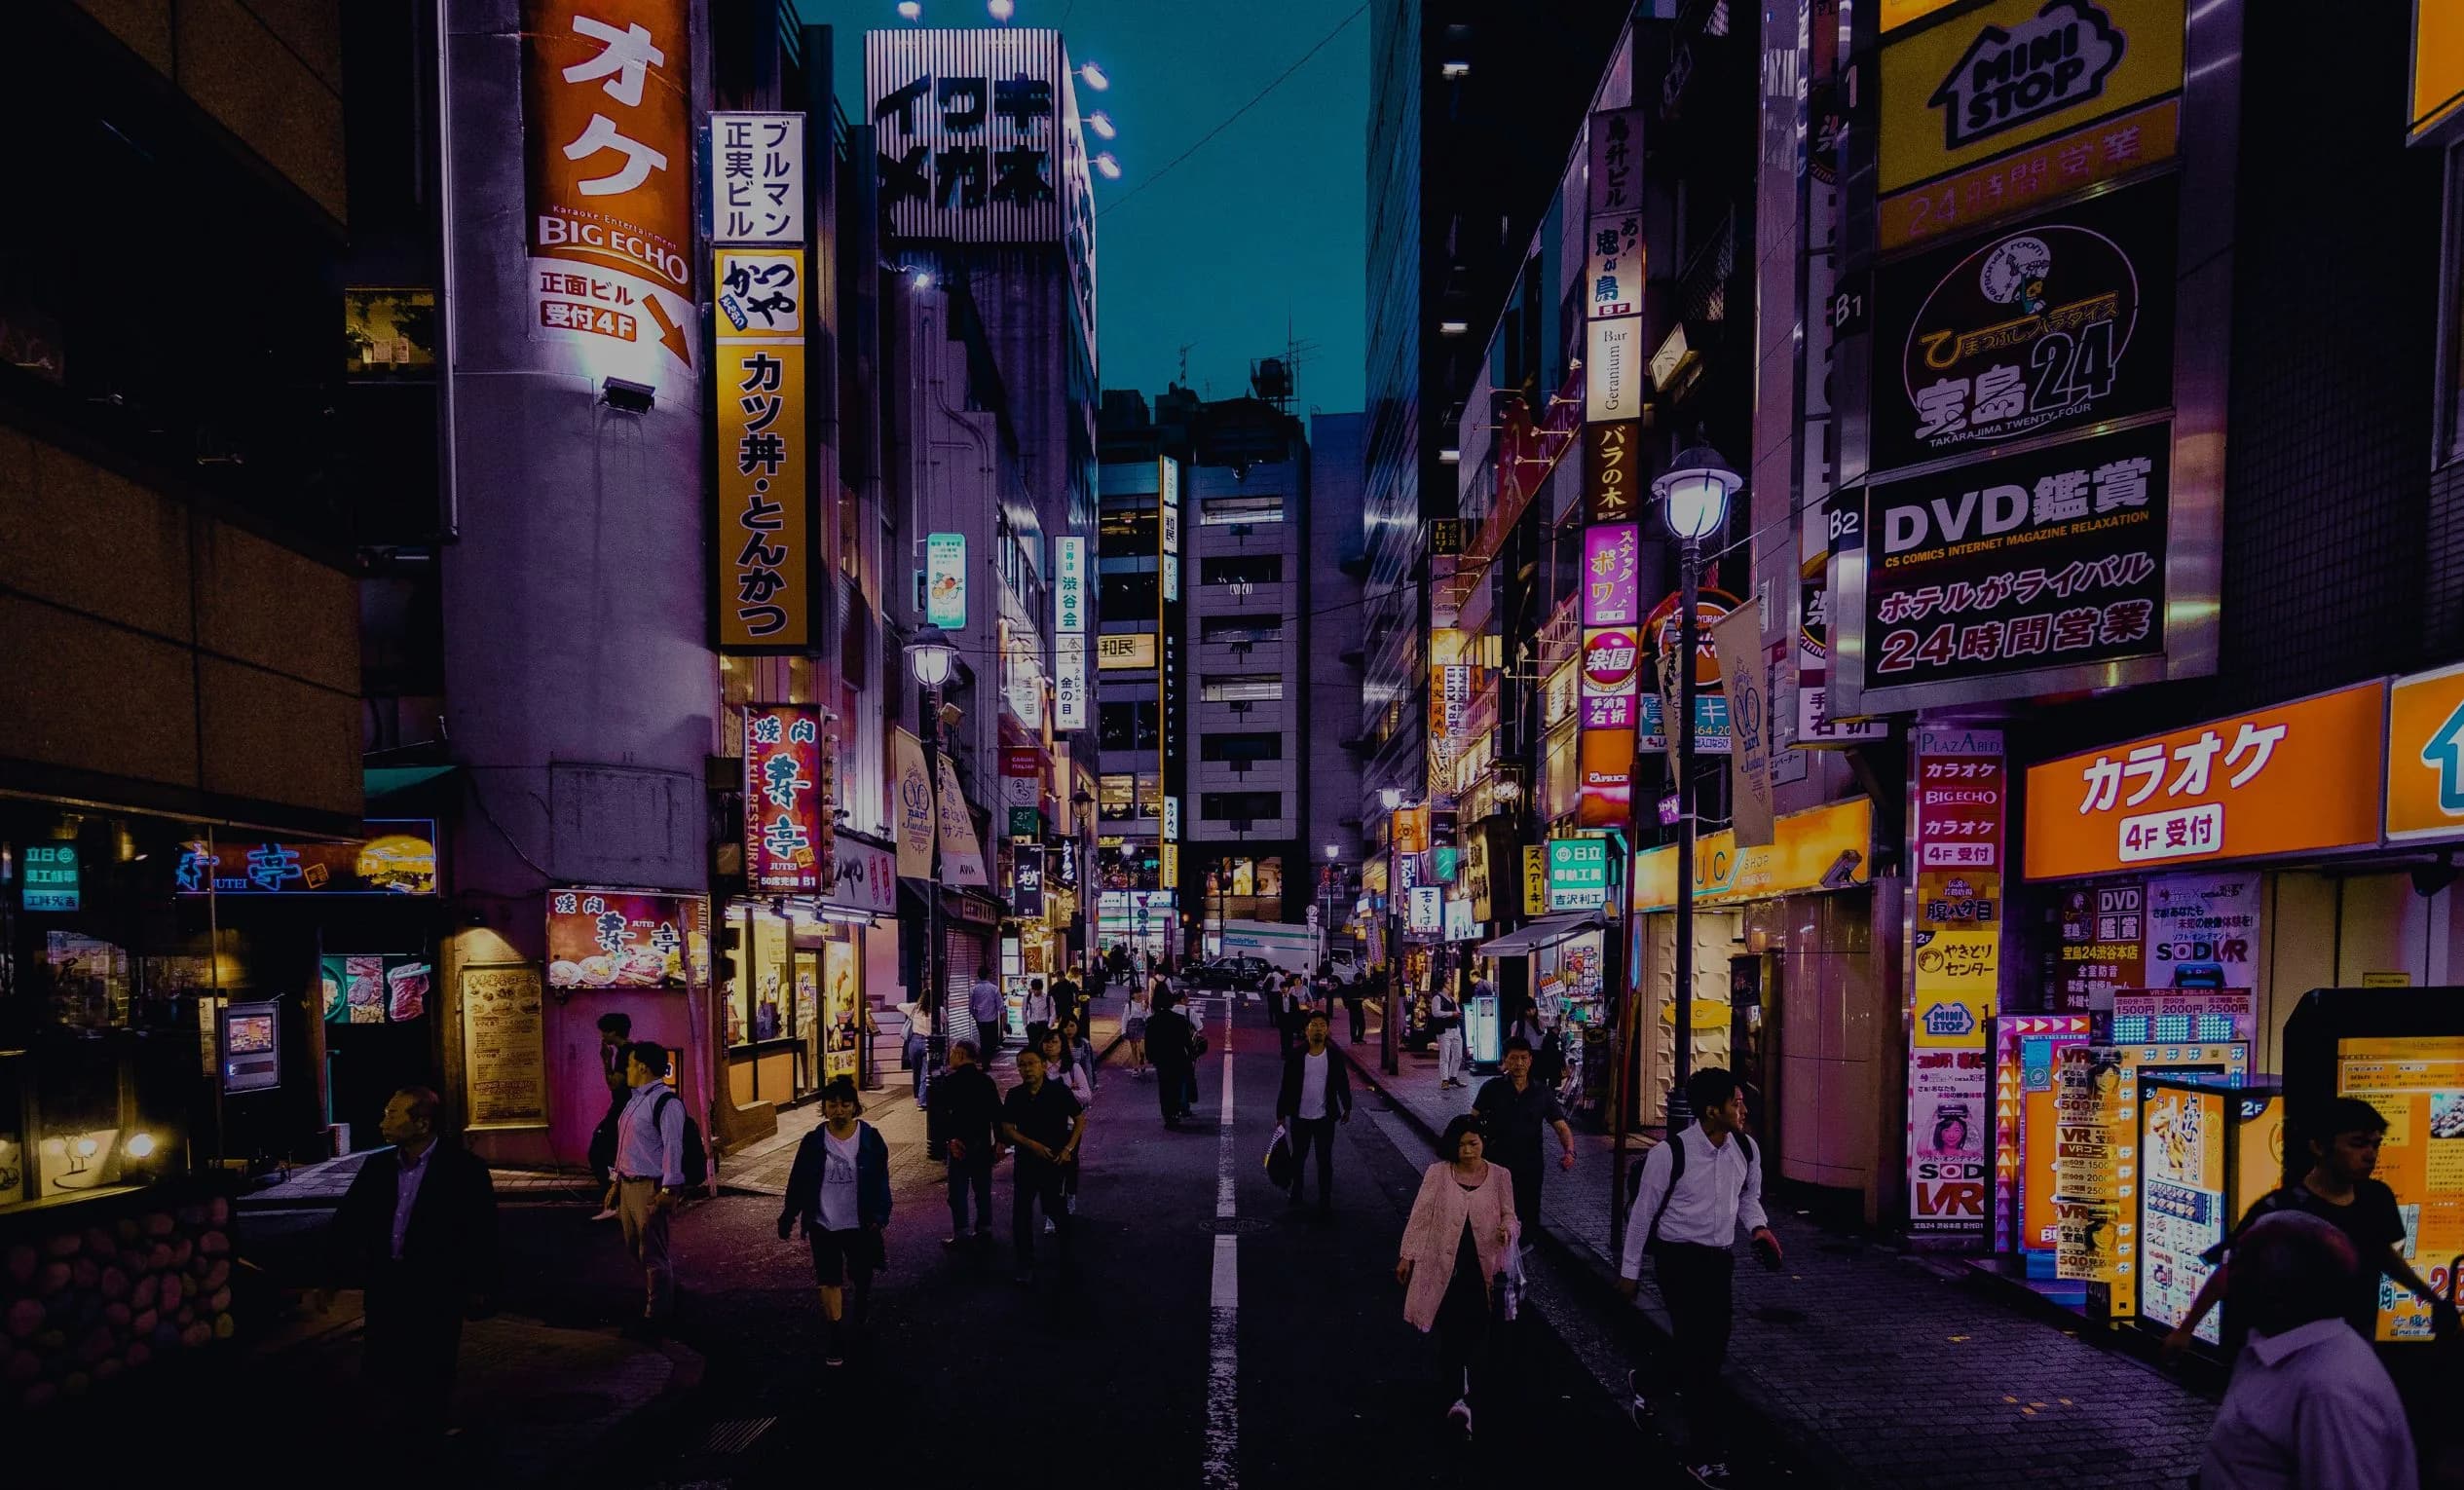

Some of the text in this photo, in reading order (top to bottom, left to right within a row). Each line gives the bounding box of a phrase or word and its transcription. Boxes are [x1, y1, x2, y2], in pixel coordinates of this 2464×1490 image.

[1973, 22, 2079, 93] MINI
[1967, 57, 2086, 129] STOP
[562, 15, 668, 197] オケ
[726, 122, 755, 238] 正実ビル
[763, 121, 792, 238] ブルマン
[1907, 125, 2142, 238] 24時間営業
[552, 204, 678, 251] Karaoke Entertainment
[539, 214, 690, 285] BIG ECHO
[2010, 241, 2044, 257] room
[1594, 229, 1621, 302] 鬼が島
[541, 272, 634, 306] 正面ビル
[544, 303, 634, 338] 受付4F
[1837, 292, 1862, 328] B1
[1604, 330, 1627, 342] Bar
[1605, 345, 1621, 411] Geranium
[1929, 424, 2002, 448] TAKARAJIMA
[1599, 424, 1627, 509] バラの木
[736, 351, 788, 638] カツ丼・とんかつ
[1885, 457, 2152, 553] DVD鑑賞
[1830, 508, 1859, 540] B2
[1885, 510, 2149, 568] CS COMICS INTERNET MAGAZINE RELAXATION
[1877, 551, 2155, 624] ホテルがライバル
[1101, 639, 1134, 655] 和民
[1877, 599, 2154, 673] 24時間営業
[1587, 647, 1636, 671] 楽園
[1061, 677, 1073, 715] 金の目
[756, 714, 816, 744] 焼肉
[1590, 709, 1627, 725] 右折
[1925, 763, 1997, 778] カラオケ
[2079, 723, 2289, 815] カラオケ
[1925, 791, 1997, 804] BIG ECHO
[1924, 820, 1996, 836] カラオケ
[2126, 815, 2214, 852] 4F 受付
[747, 794, 760, 891] RESTAURANT
[1574, 846, 1602, 861] 日立
[1928, 846, 1989, 862] 4F 受付
[803, 876, 816, 887] B1
[555, 893, 605, 913] 焼肉
[1926, 898, 1994, 922] 腹八分目
[2102, 890, 2139, 912] DVD
[1944, 944, 1993, 958] やきとり
[2062, 945, 2139, 961] 宝島24渋谷本店
[1945, 961, 1995, 977] センター
[2077, 965, 2119, 977] 全室防音
[1933, 1011, 1963, 1022] MINI
[2116, 1005, 2155, 1015] 1500円
[2162, 1004, 2203, 1014] 2000円
[2208, 1003, 2249, 1014] 2500円
[1932, 1021, 1964, 1031] STOP
[2061, 1049, 2091, 1063] VR
[2240, 1100, 2263, 1116] 2F
[2061, 1128, 2092, 1143] VR
[1918, 1163, 1985, 1179] SOD
[1916, 1181, 1986, 1215] VR
[2059, 1204, 2089, 1219] VR
